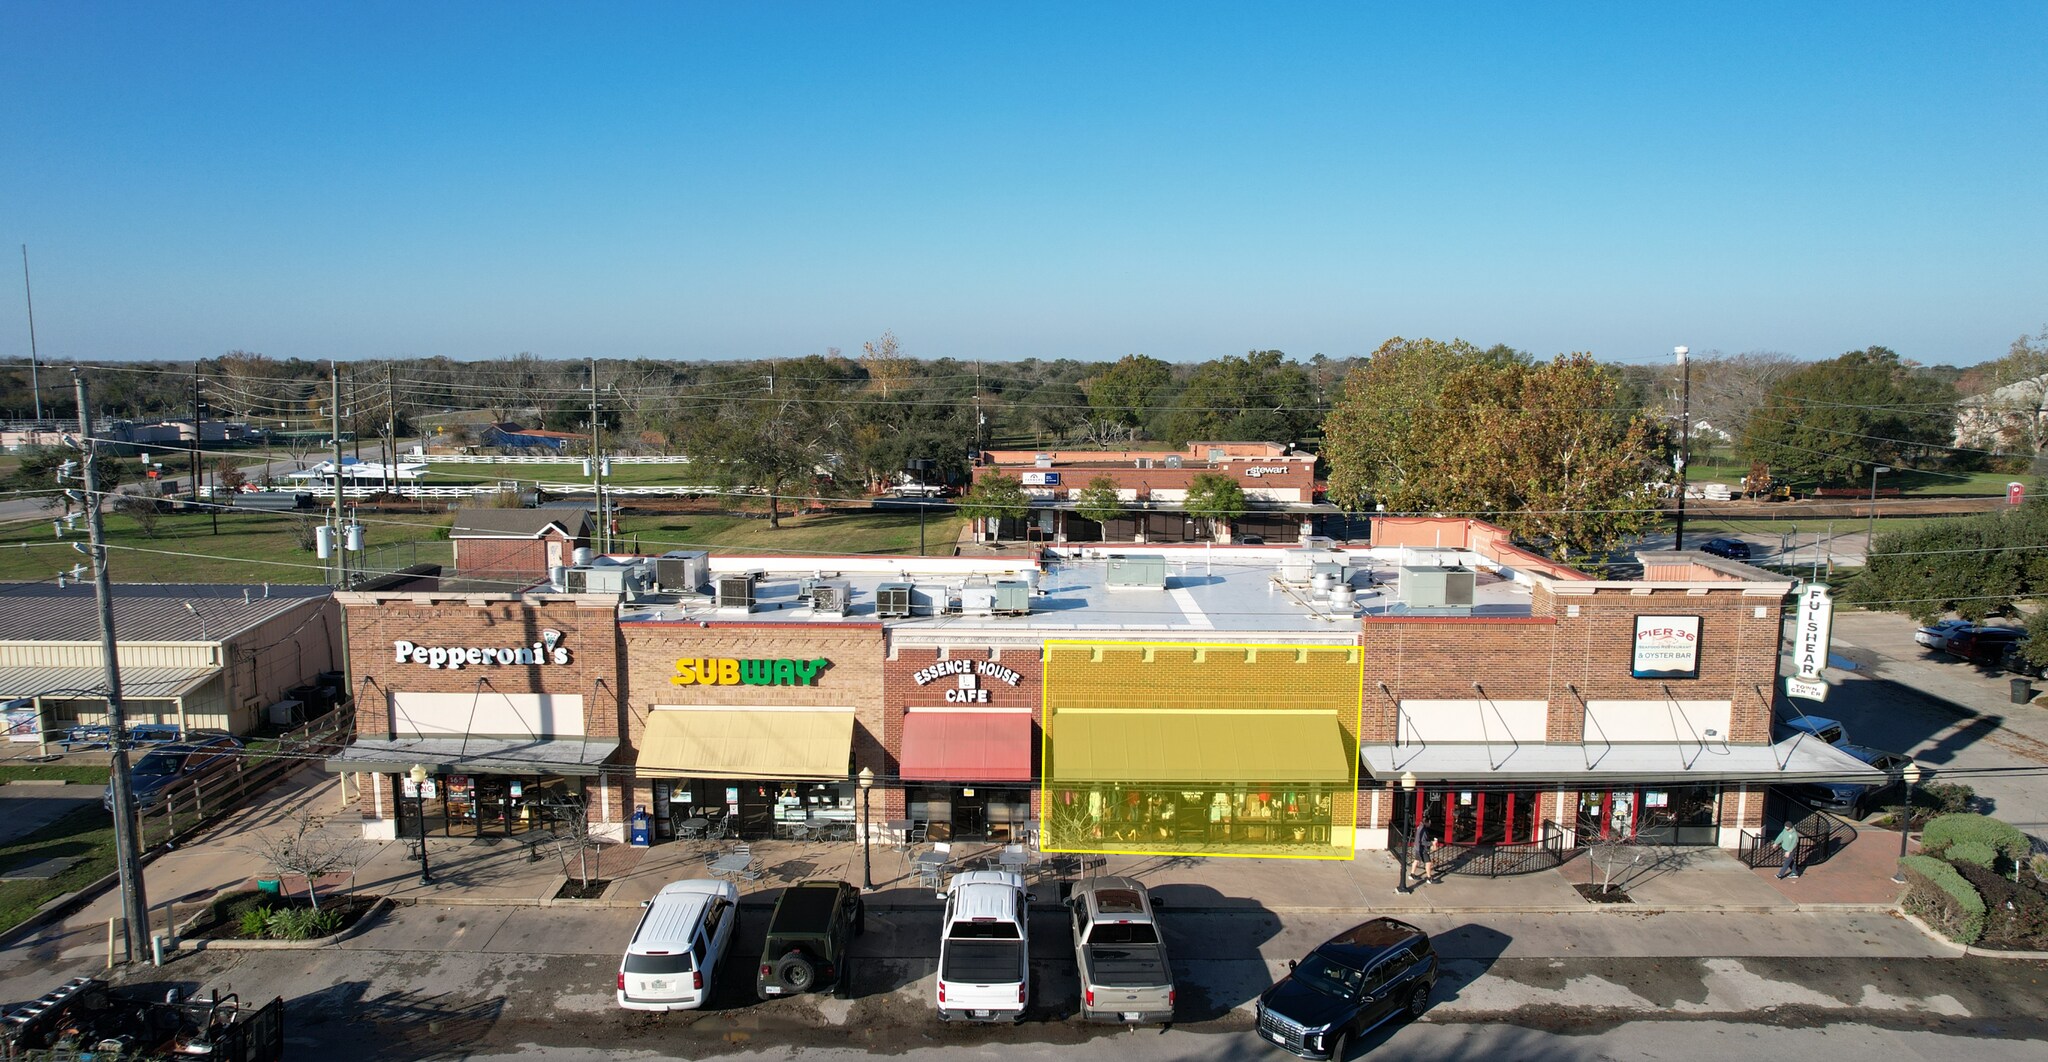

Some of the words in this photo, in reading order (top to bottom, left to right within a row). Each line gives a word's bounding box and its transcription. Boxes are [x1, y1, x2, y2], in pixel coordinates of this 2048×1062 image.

[1250, 466, 1288, 474] stewart
[1638, 628, 1673, 640] PIER
[1676, 629, 1695, 641] 36
[1803, 590, 1821, 674] FULSHEAR
[394, 629, 568, 669] Pepperoni's
[670, 656, 828, 686] SUBWAY
[913, 660, 971, 686] ESSENCE
[978, 661, 1020, 686] HOUSE
[945, 689, 988, 702] CAFE
[1791, 687, 1821, 697] CENER
